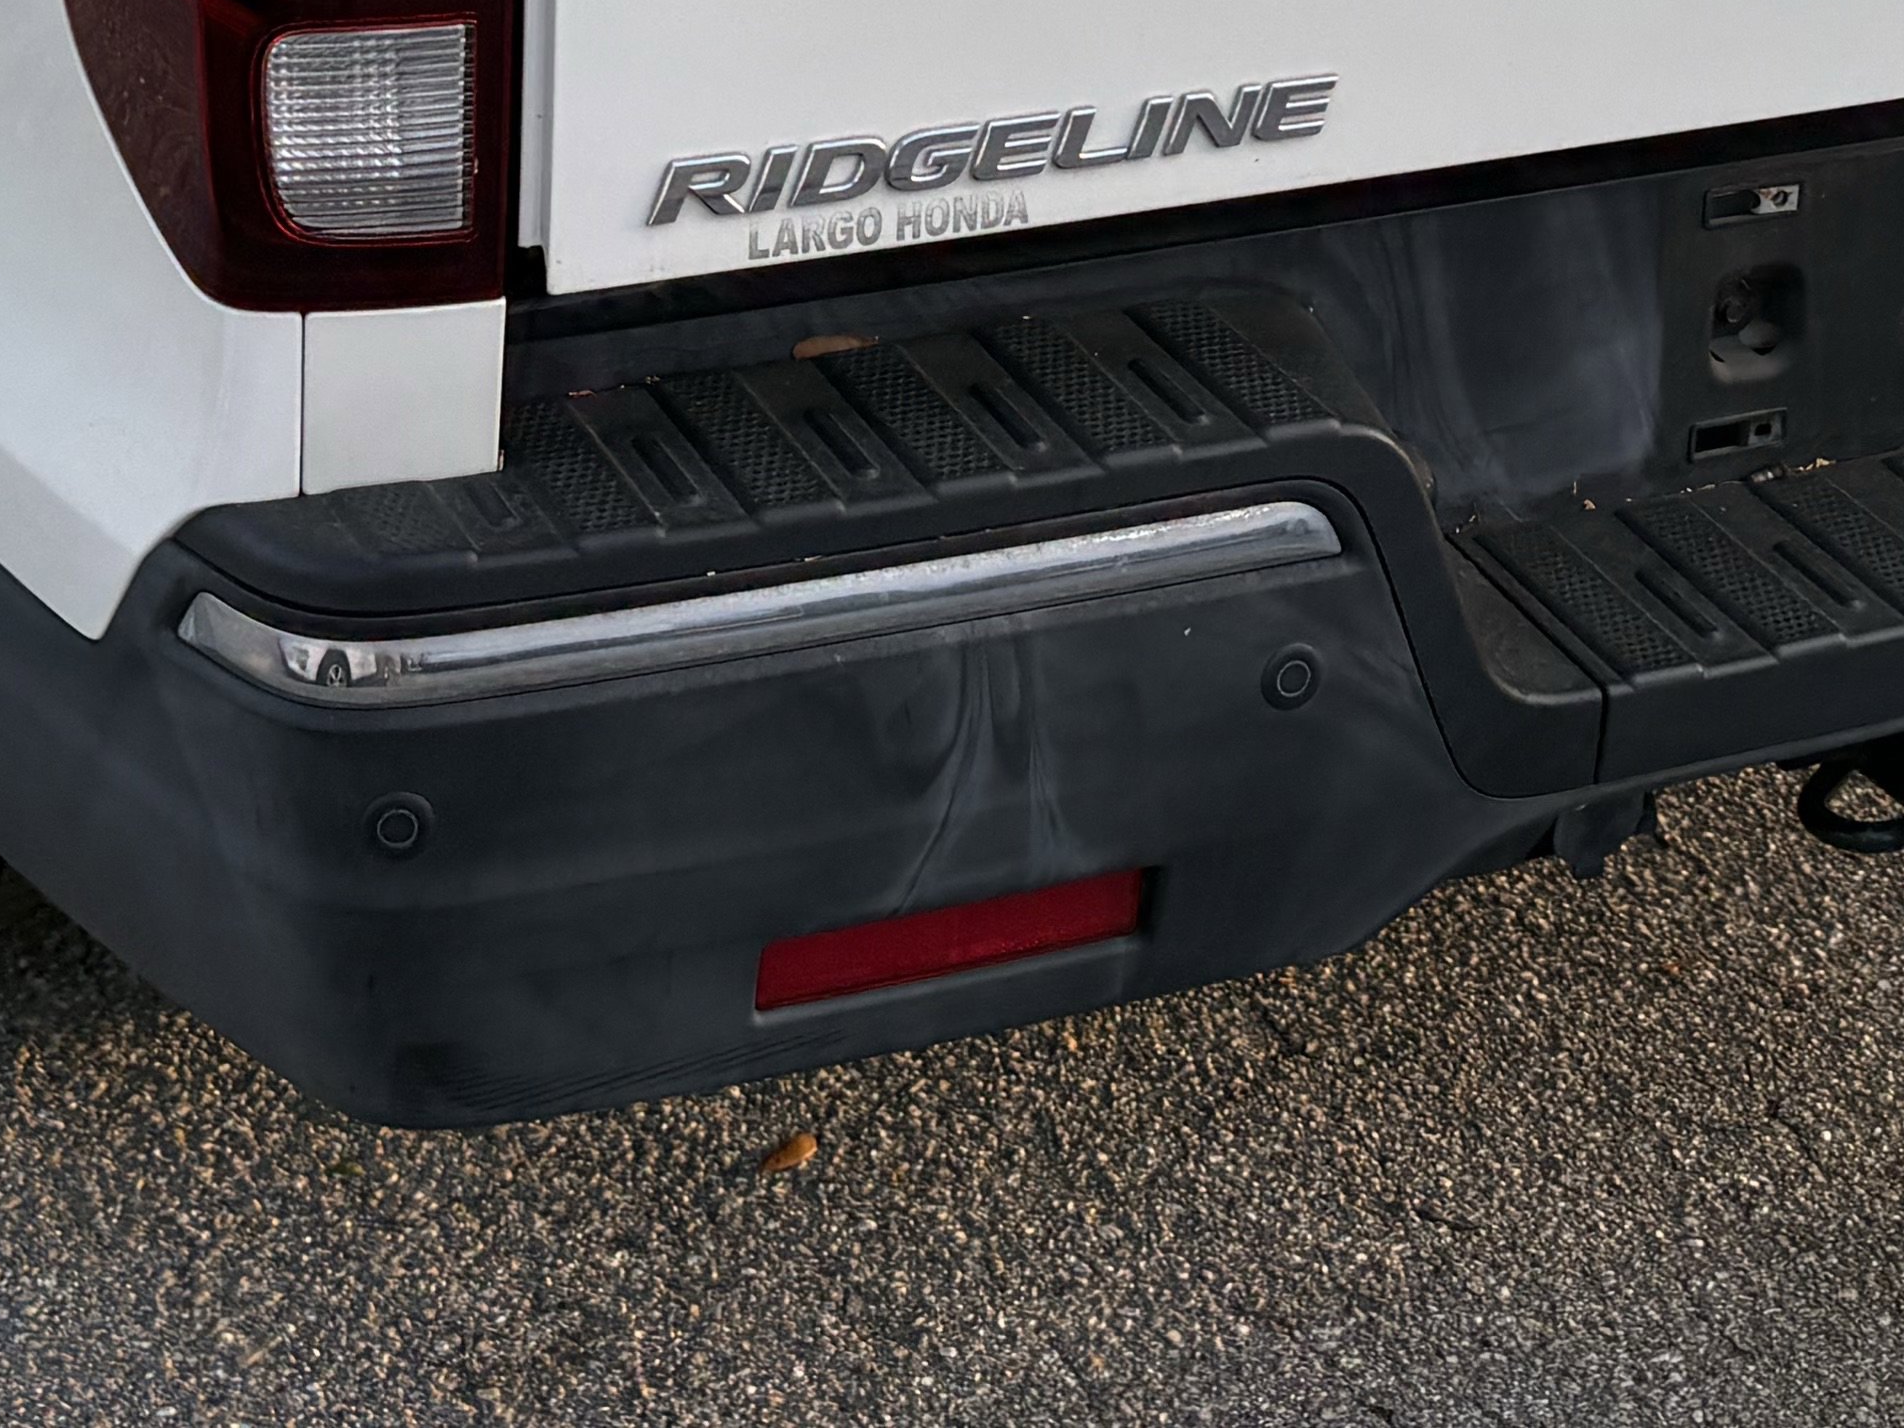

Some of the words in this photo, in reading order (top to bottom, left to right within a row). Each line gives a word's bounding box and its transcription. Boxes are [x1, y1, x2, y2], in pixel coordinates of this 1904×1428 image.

[645, 72, 1339, 227] RIDGELINE
[747, 206, 883, 261] LARGO
[895, 190, 1030, 241] HONDA
